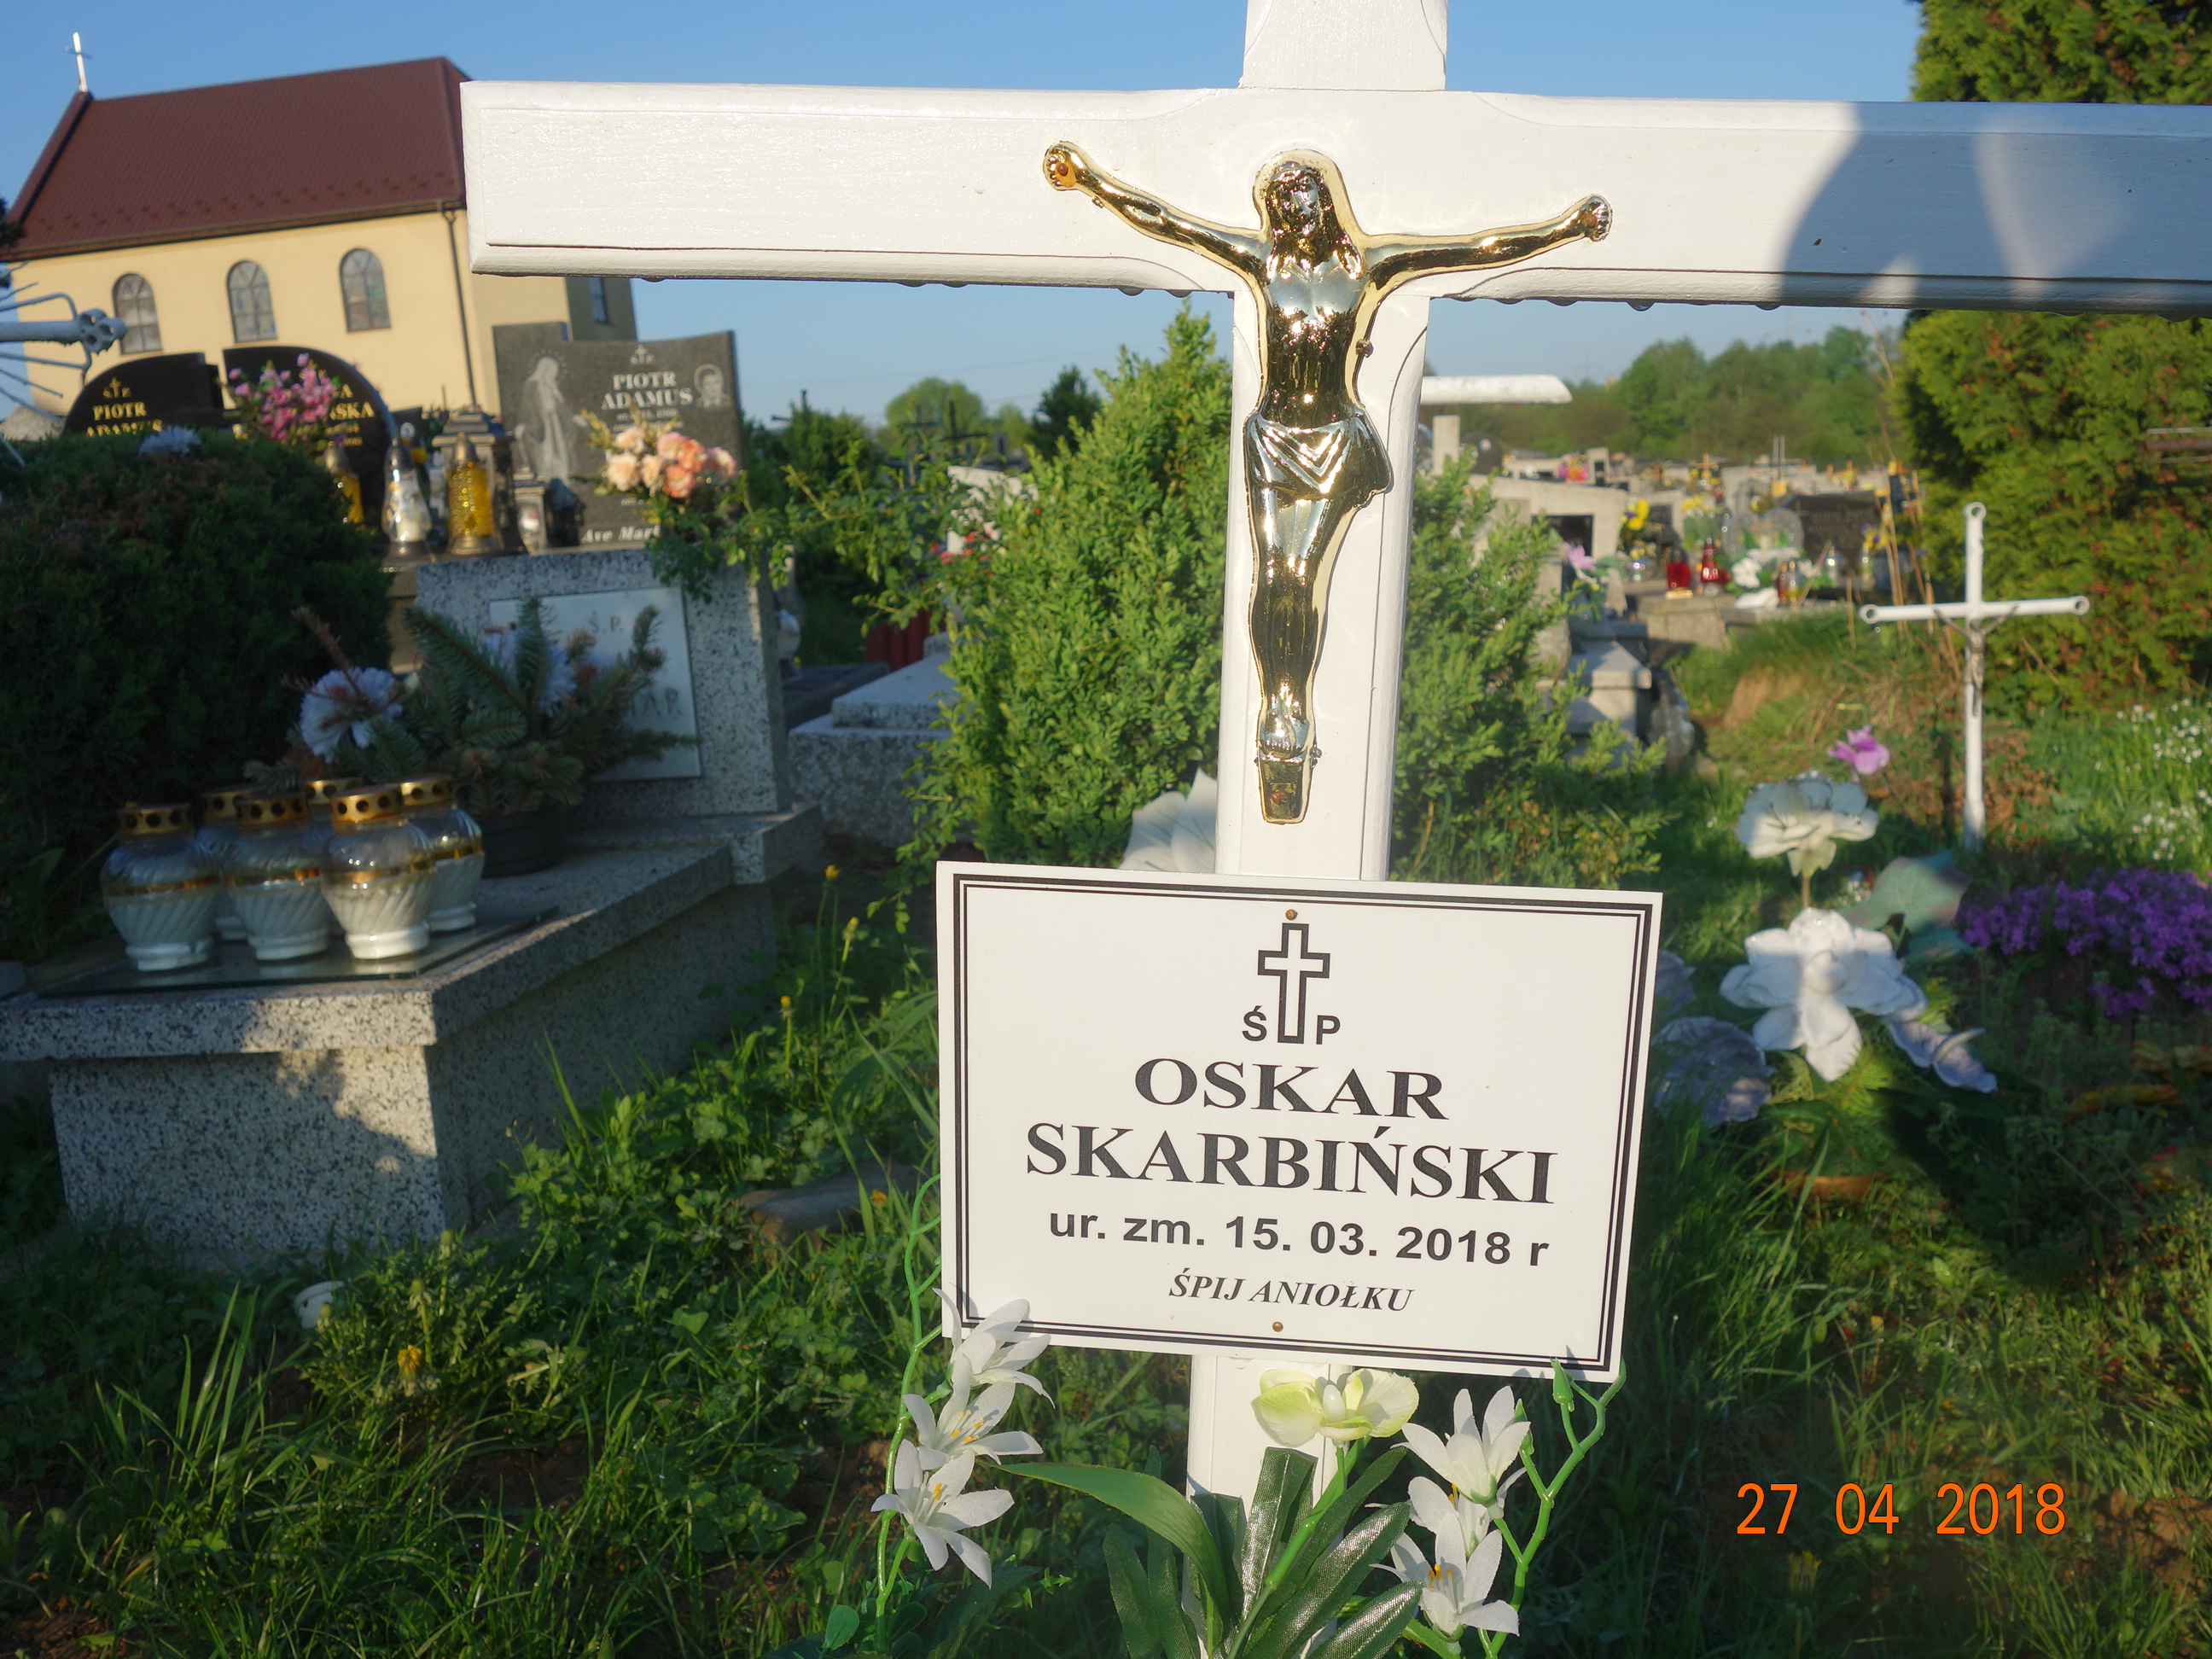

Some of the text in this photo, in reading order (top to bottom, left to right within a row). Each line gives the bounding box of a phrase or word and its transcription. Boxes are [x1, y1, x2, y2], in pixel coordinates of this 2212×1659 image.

[601, 387, 693, 410] ADAMUS
[613, 370, 678, 390] PIOTR
[92, 401, 147, 421] PIOTR
[581, 528, 614, 543] Ave
[1242, 1004, 1341, 1045] Ś P
[1135, 1058, 1449, 1121] OSKAR
[1027, 1122, 1557, 1204] SKARBIŃSKI
[1050, 1213, 1550, 1266] ur. zm. 15. 03. 2018 r
[1168, 1267, 1416, 1312] ŚPIJ ANIOŁKU
